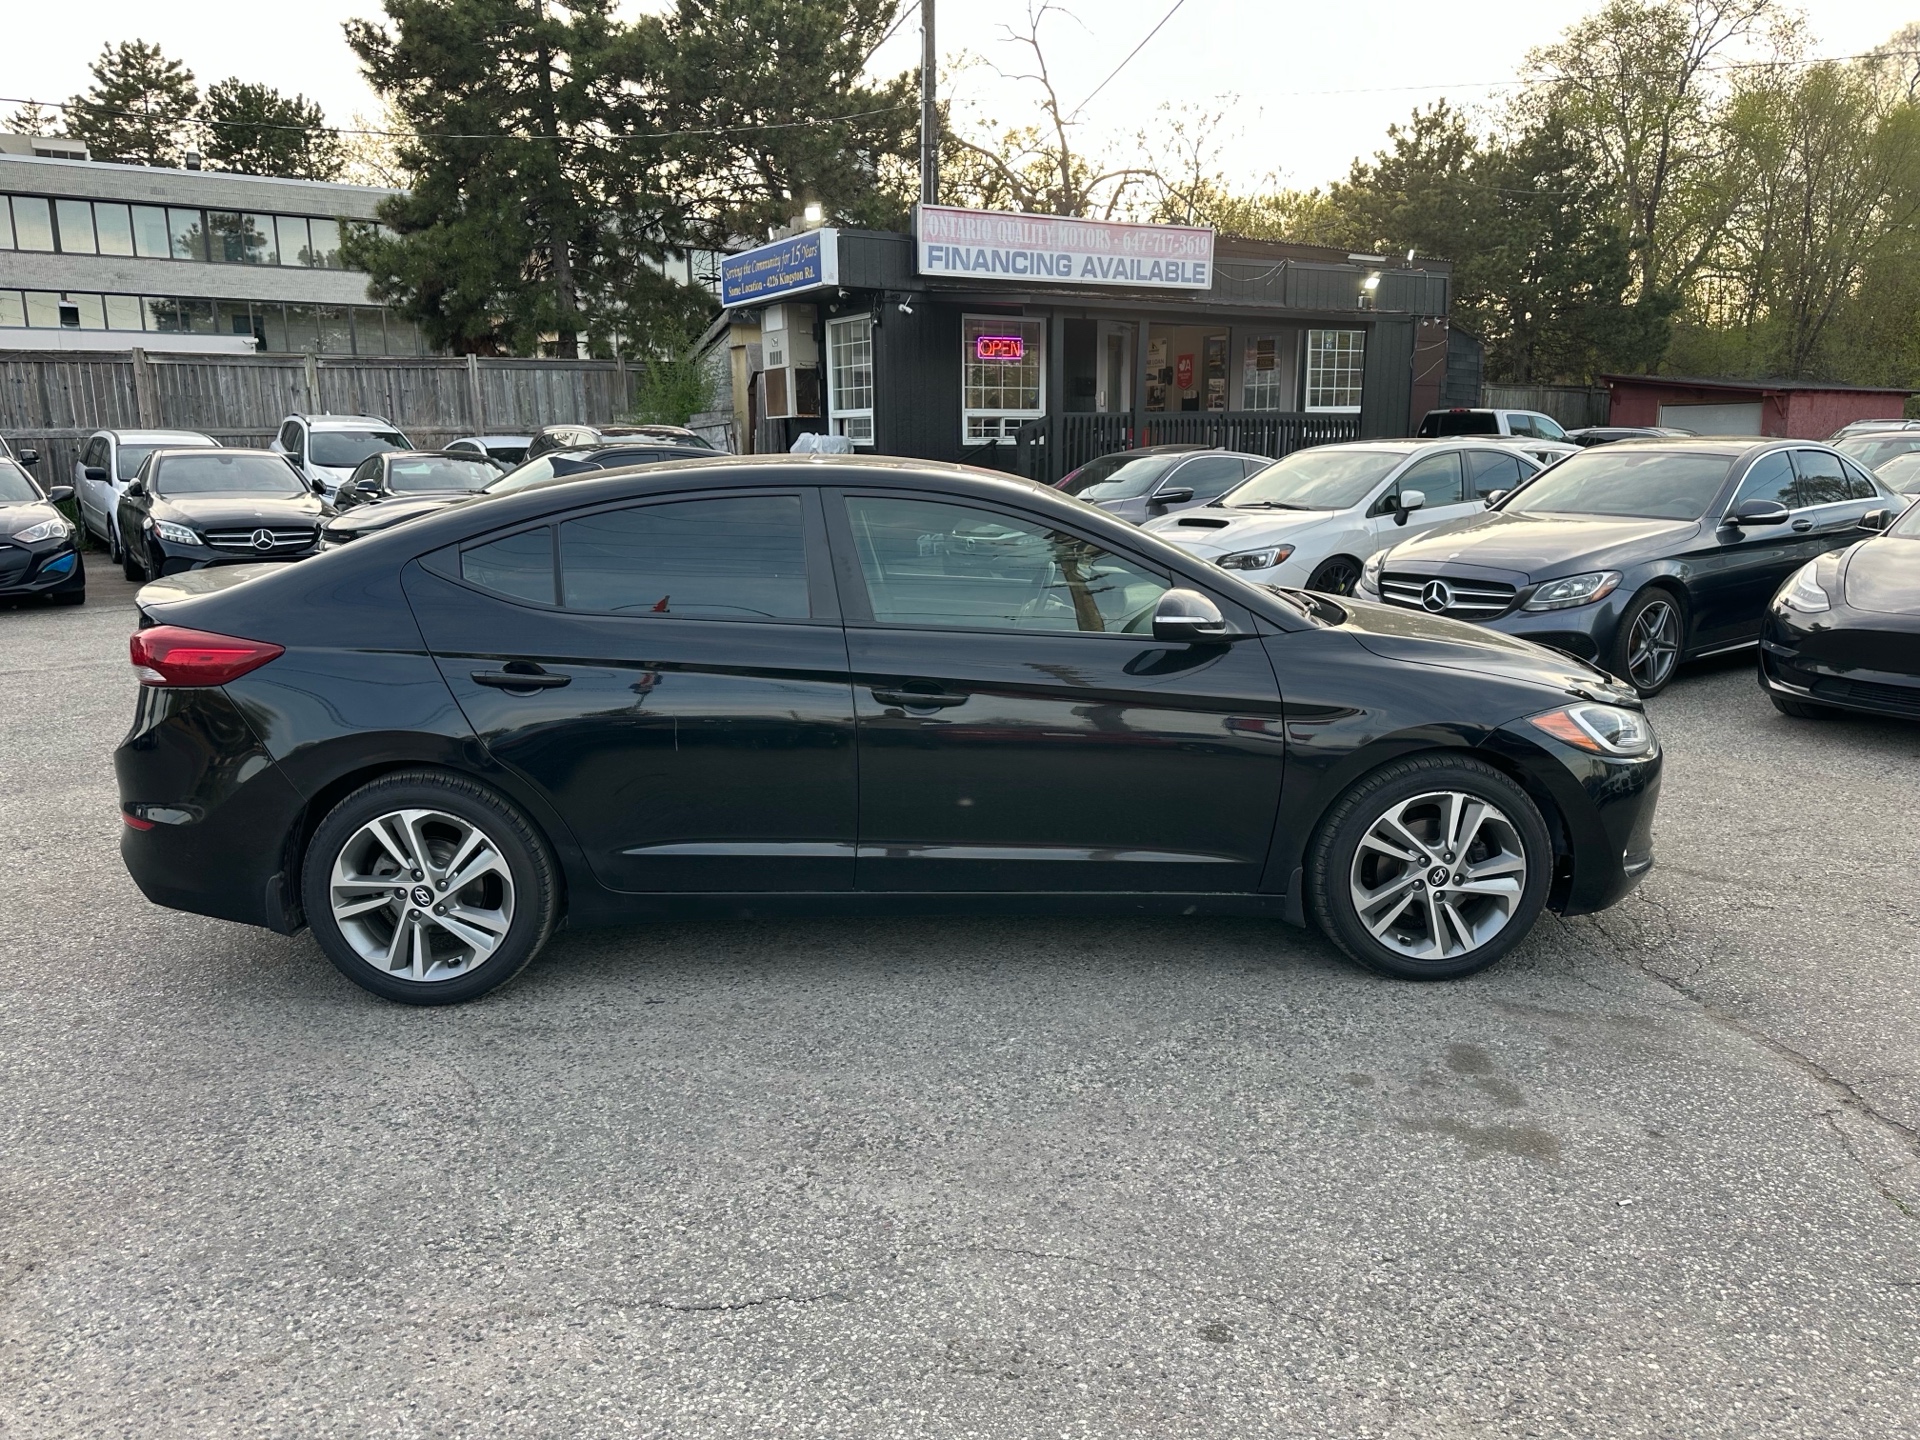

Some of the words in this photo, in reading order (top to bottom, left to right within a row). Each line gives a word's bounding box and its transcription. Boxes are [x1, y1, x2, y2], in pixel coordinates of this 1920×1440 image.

[928, 214, 992, 240] ONTARIO
[997, 220, 1054, 246] QUALITY
[1060, 225, 1111, 250] MOTORS
[1122, 231, 1209, 256] 647-717-3619
[743, 260, 751, 275] the
[751, 254, 781, 272] Community
[780, 249, 790, 272] for
[790, 243, 802, 265] 15
[928, 245, 1073, 277] FINANCING
[1080, 256, 1206, 283] AVAILABLE
[741, 280, 762, 293] Location
[779, 271, 804, 286] Kingston
[980, 340, 1020, 357] OPEN
